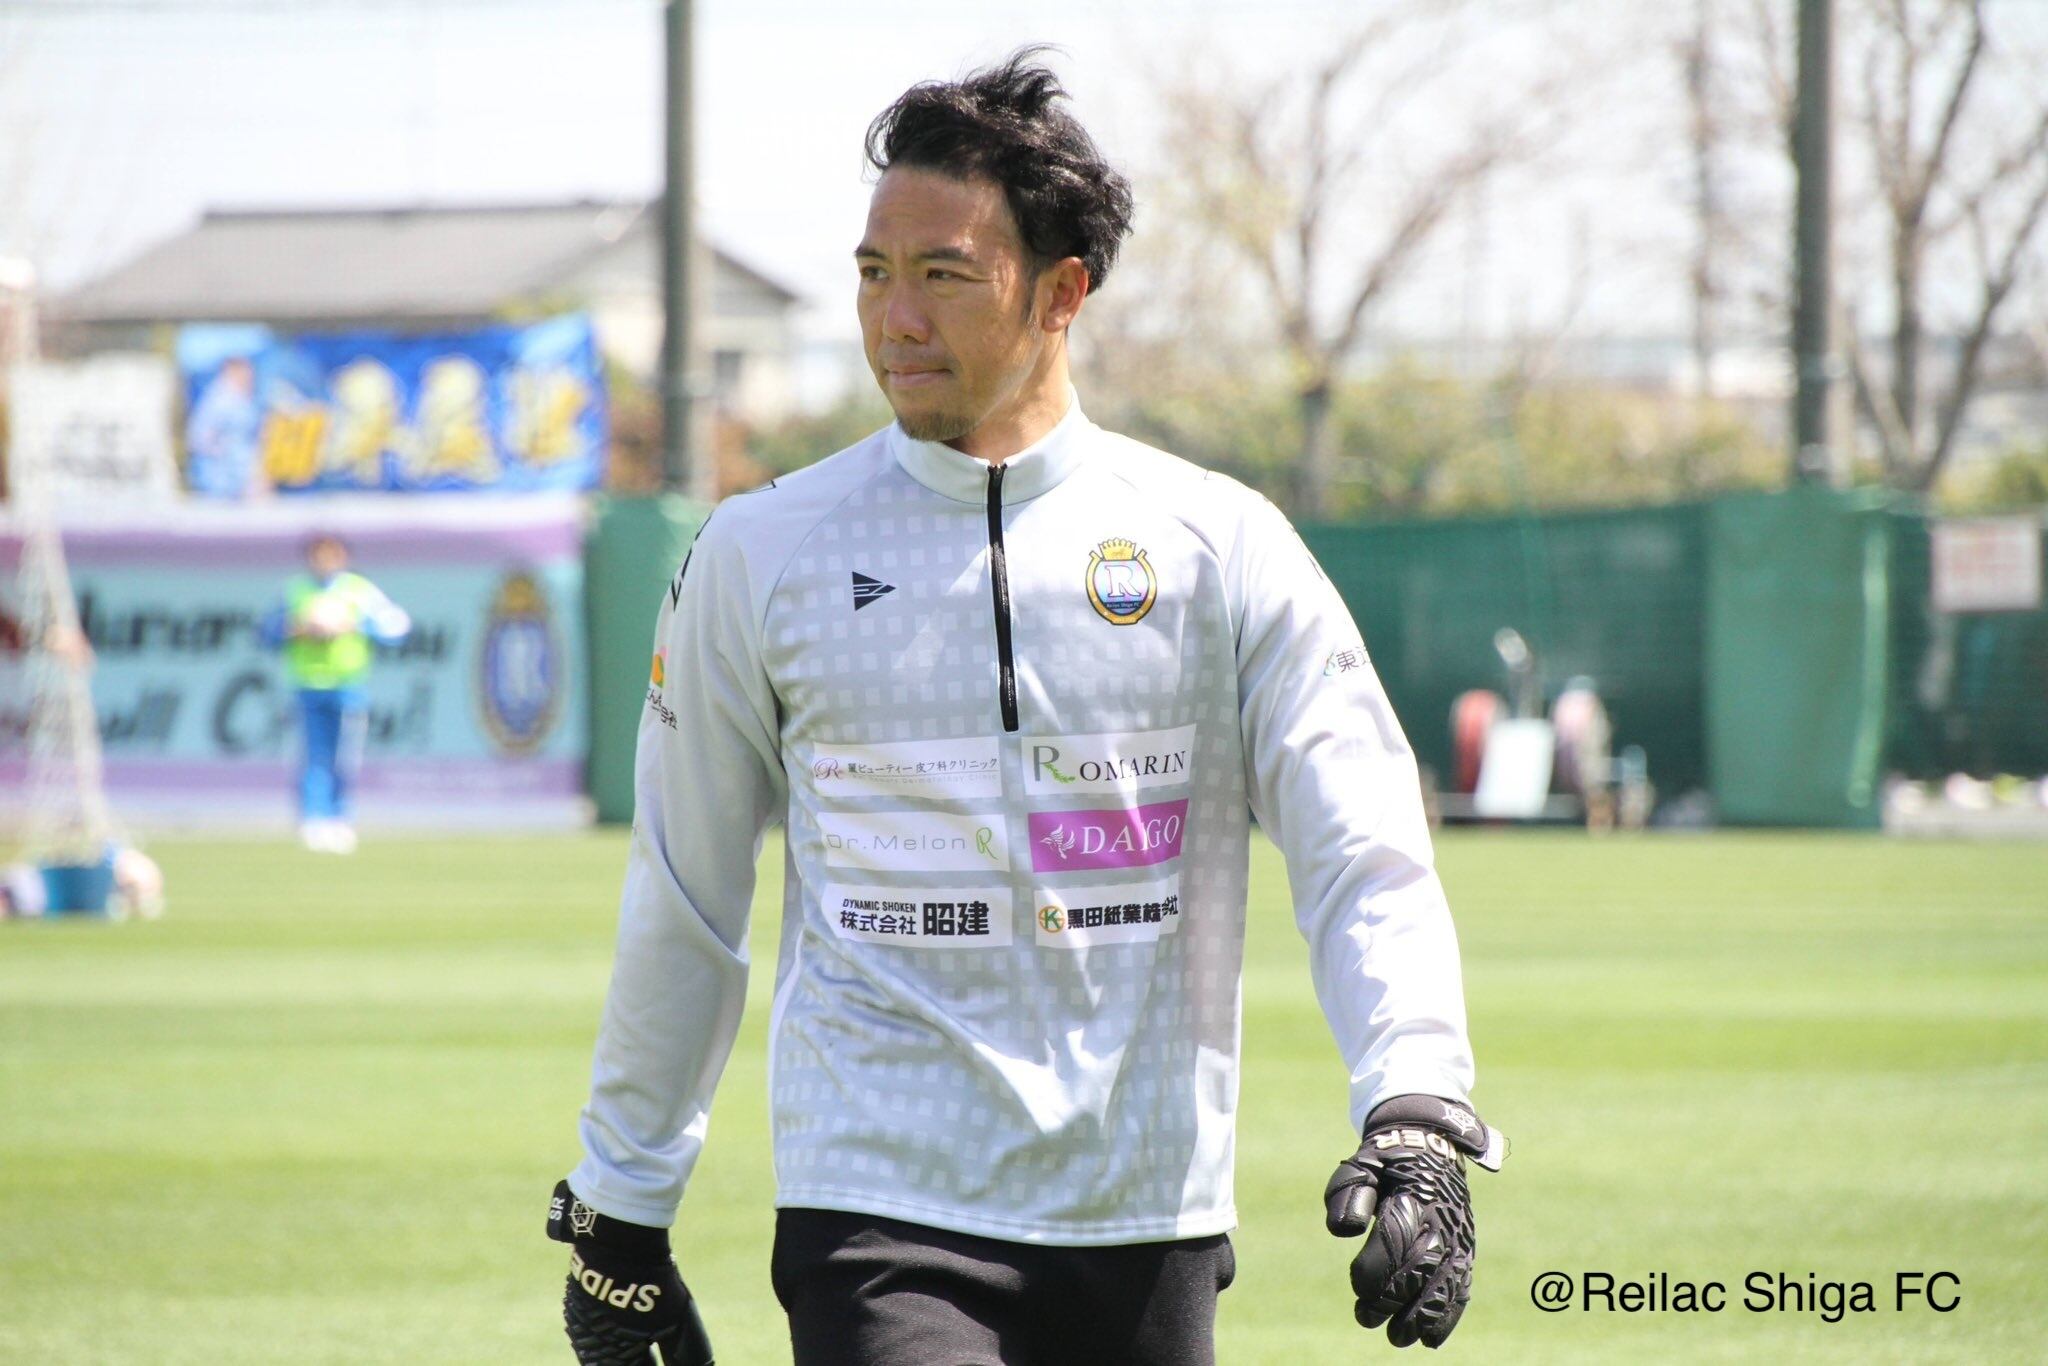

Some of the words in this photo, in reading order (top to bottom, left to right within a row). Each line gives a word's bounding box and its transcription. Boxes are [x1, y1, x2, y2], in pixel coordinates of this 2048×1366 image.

[1104, 564, 1142, 598] R
[1033, 745, 1186, 784] ROMARIN
[1080, 814, 1180, 855] DAIGO
[842, 898, 880, 911] DYNAMIC
[882, 902, 917, 914] SHOKEN
